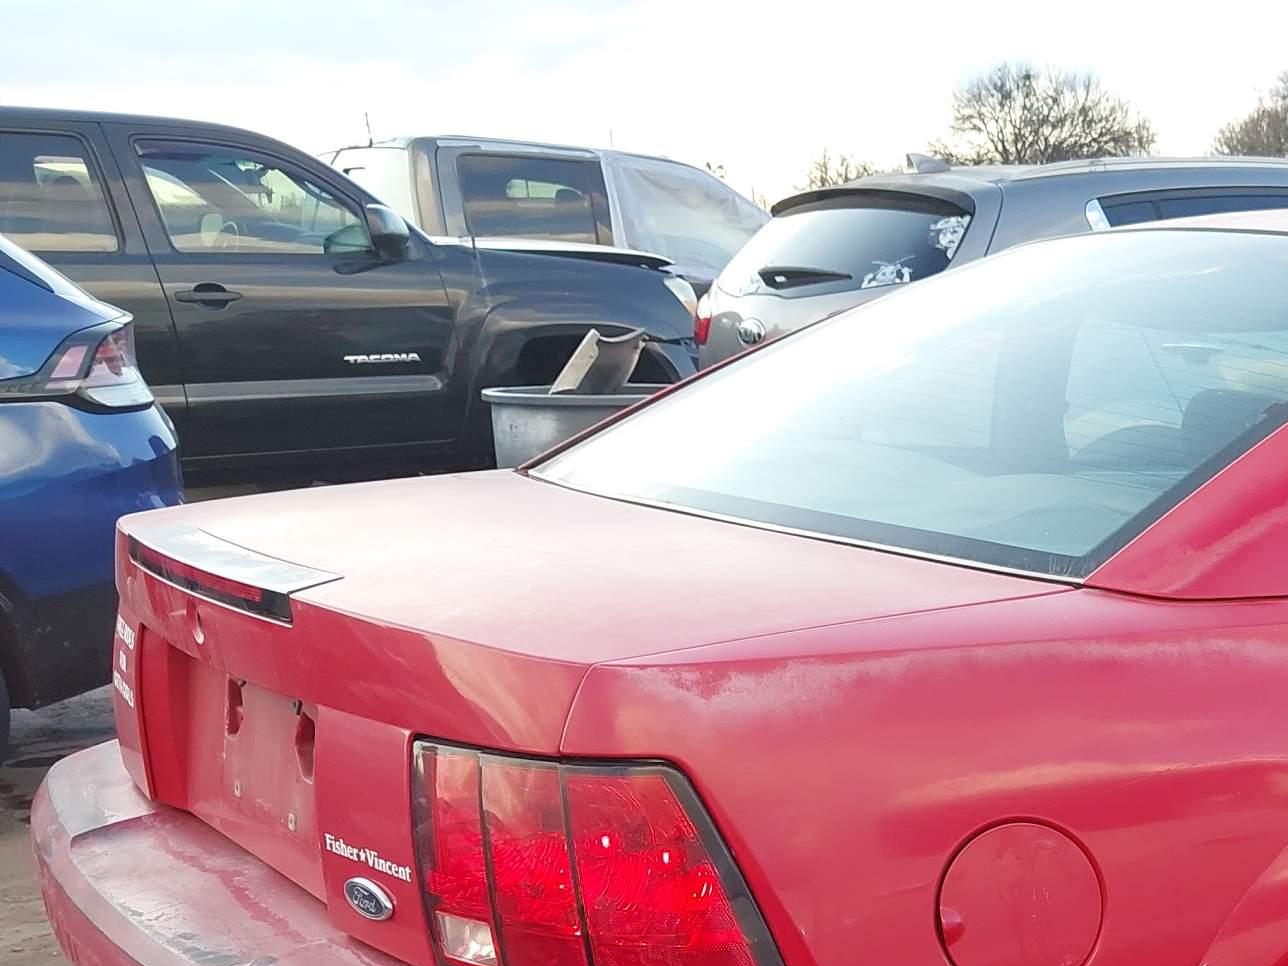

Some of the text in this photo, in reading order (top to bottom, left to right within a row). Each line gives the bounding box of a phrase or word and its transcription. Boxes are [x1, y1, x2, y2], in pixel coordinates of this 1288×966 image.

[343, 352, 421, 364] TACOMA
[325, 833, 412, 883] Fisher Vincent
[352, 886, 377, 913] Ford
